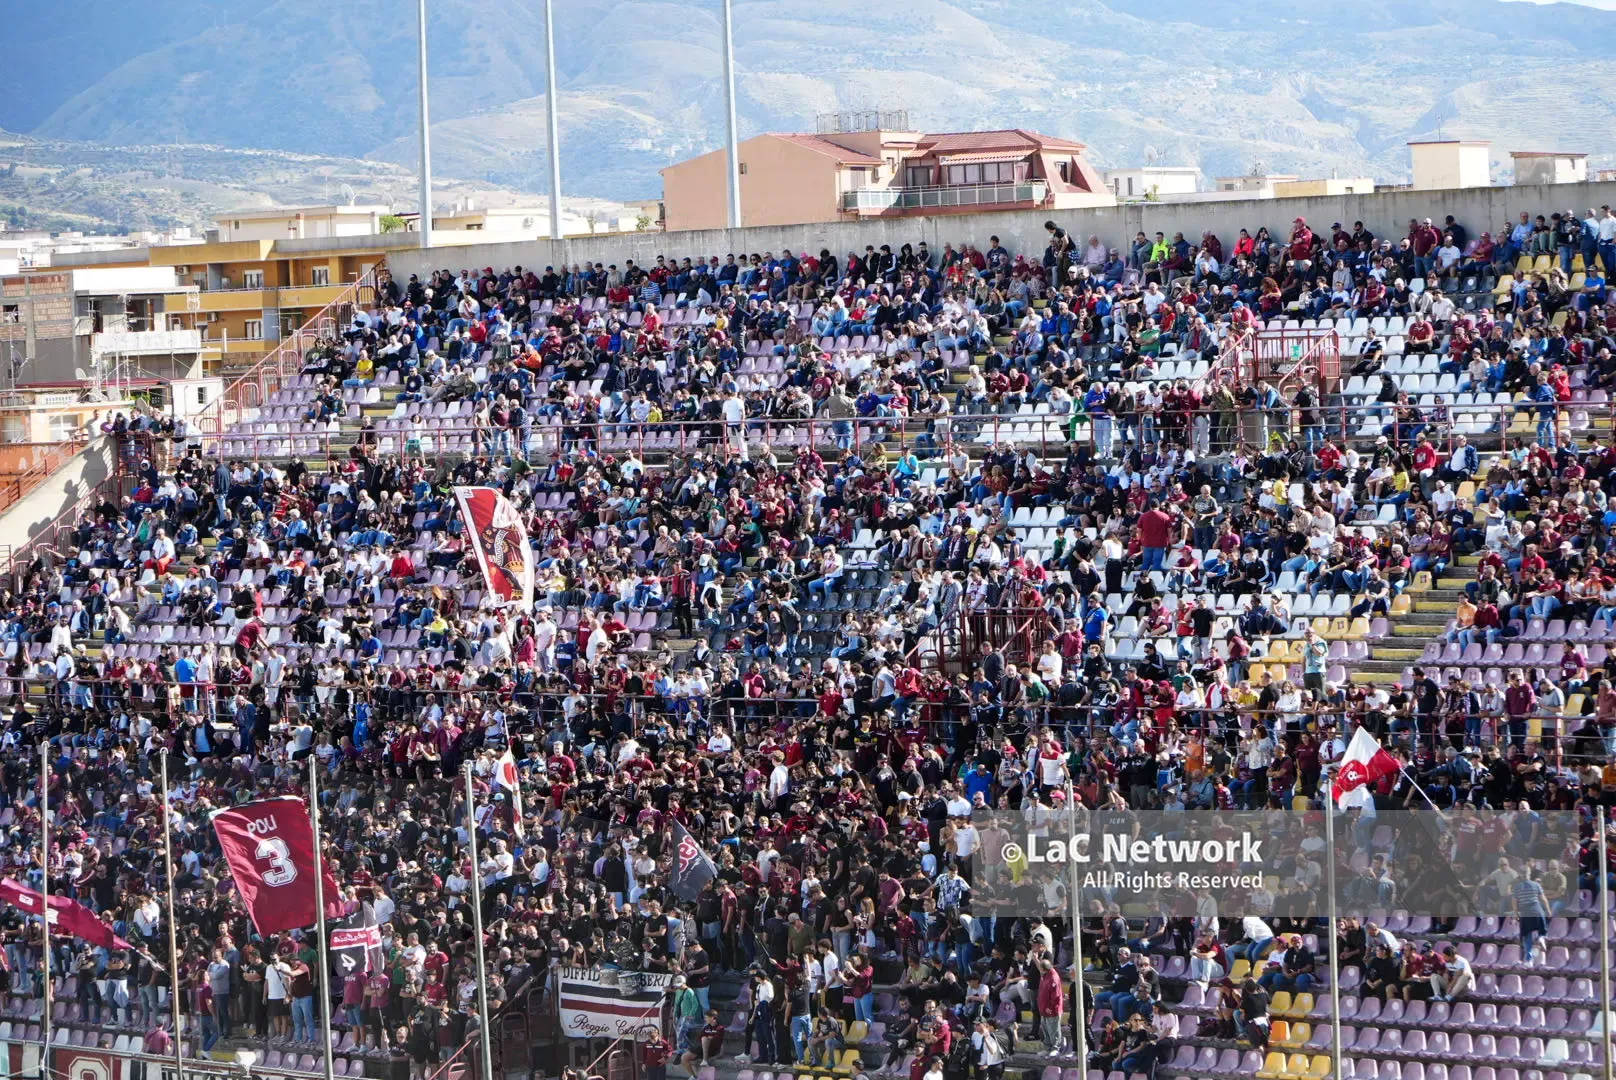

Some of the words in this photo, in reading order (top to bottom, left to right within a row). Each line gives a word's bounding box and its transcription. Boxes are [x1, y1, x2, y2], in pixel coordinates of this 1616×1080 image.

[247, 814, 278, 834] POLI
[255, 836, 298, 888] 3
[563, 966, 600, 982] DIFFID
[569, 1013, 610, 1036] Reggio
